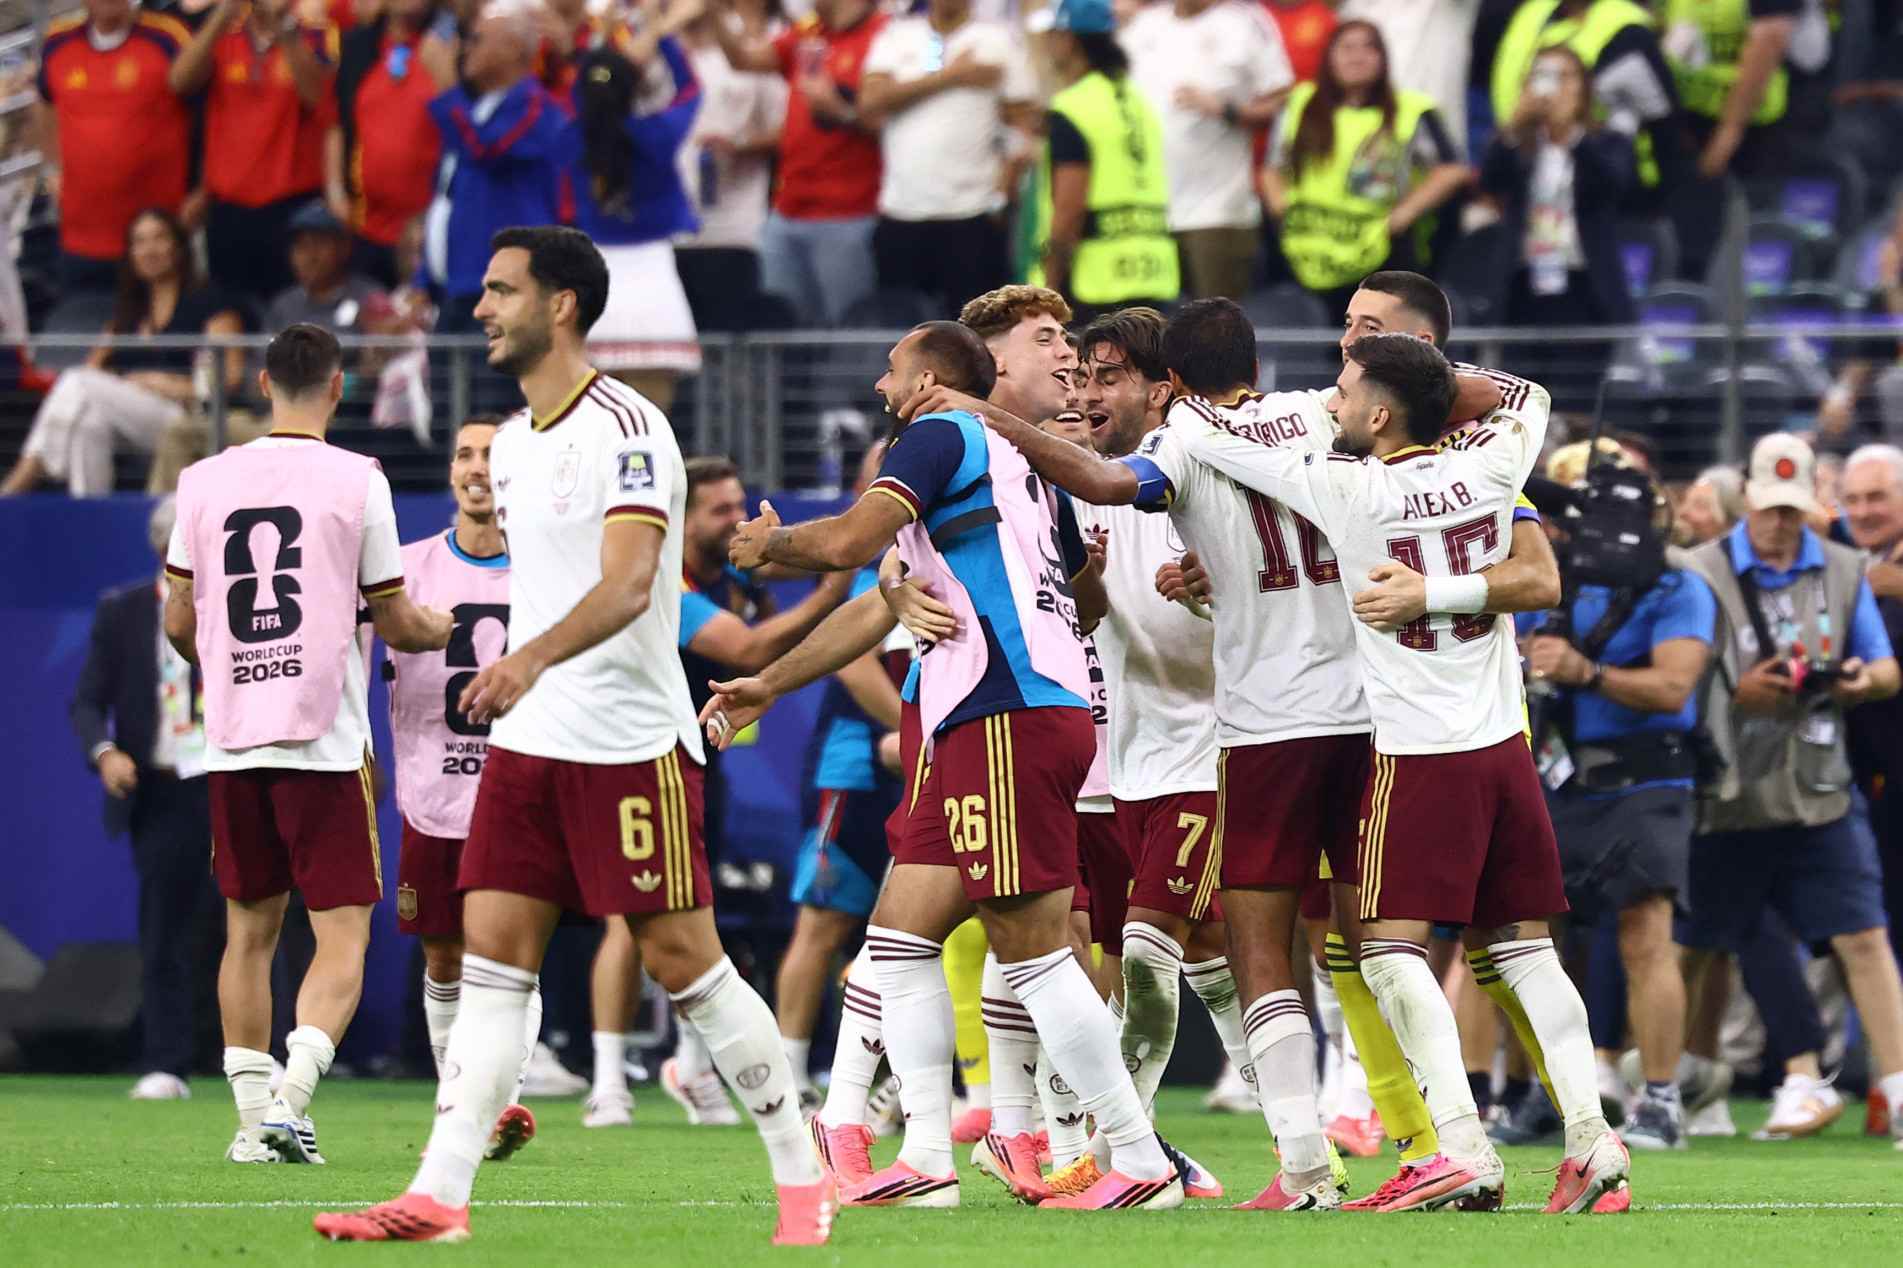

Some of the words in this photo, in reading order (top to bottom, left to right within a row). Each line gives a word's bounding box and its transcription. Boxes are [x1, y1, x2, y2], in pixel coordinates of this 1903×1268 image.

[1403, 489, 1456, 520] ALEX
[1451, 481, 1478, 507] B.
[252, 613, 282, 632] FIFA
[231, 647, 276, 663] WORLD
[276, 644, 303, 657] CUP
[232, 659, 303, 685] 2026
[442, 757, 488, 775] 20
[619, 796, 655, 860] 6
[943, 794, 988, 853] 26
[1175, 812, 1209, 867] 7
